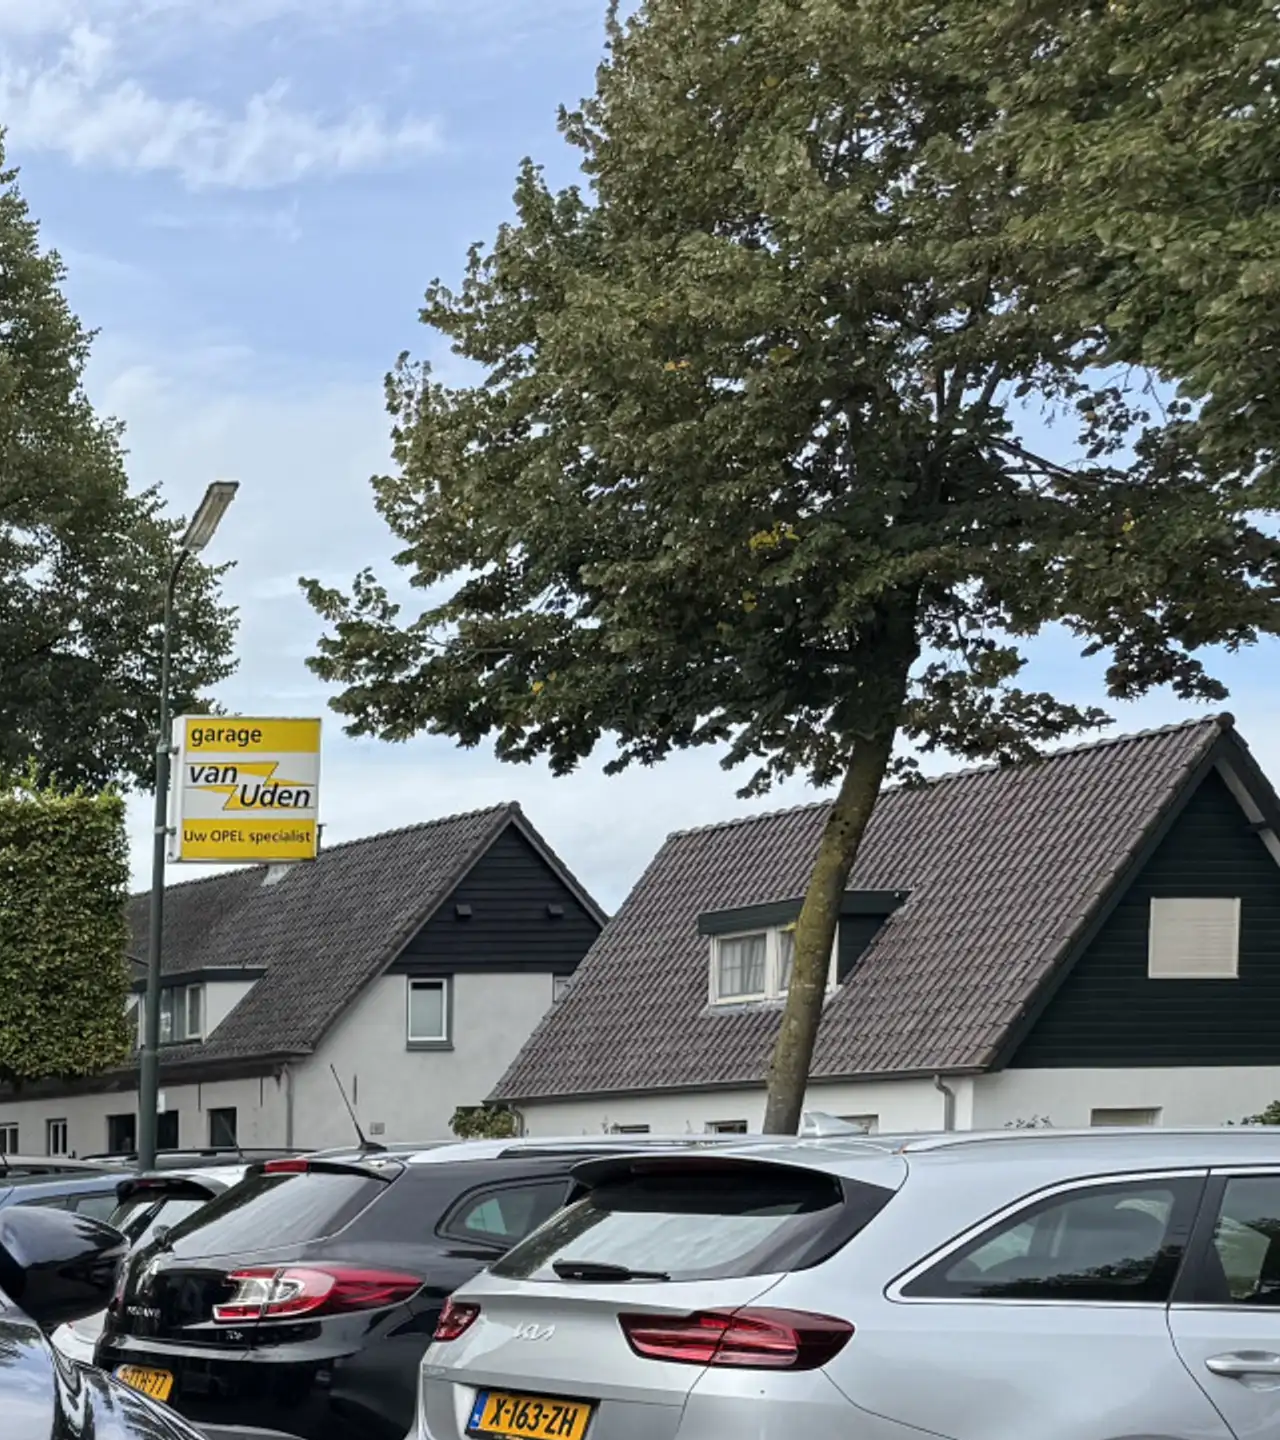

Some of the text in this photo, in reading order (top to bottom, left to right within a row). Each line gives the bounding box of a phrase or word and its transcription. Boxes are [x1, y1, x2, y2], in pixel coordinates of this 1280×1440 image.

[190, 728, 262, 748] garage
[190, 764, 237, 784] van
[239, 784, 310, 808] Uden
[183, 830, 311, 844] Uw OPEL specialist
[489, 1398, 579, 1438] X-163-ZH
